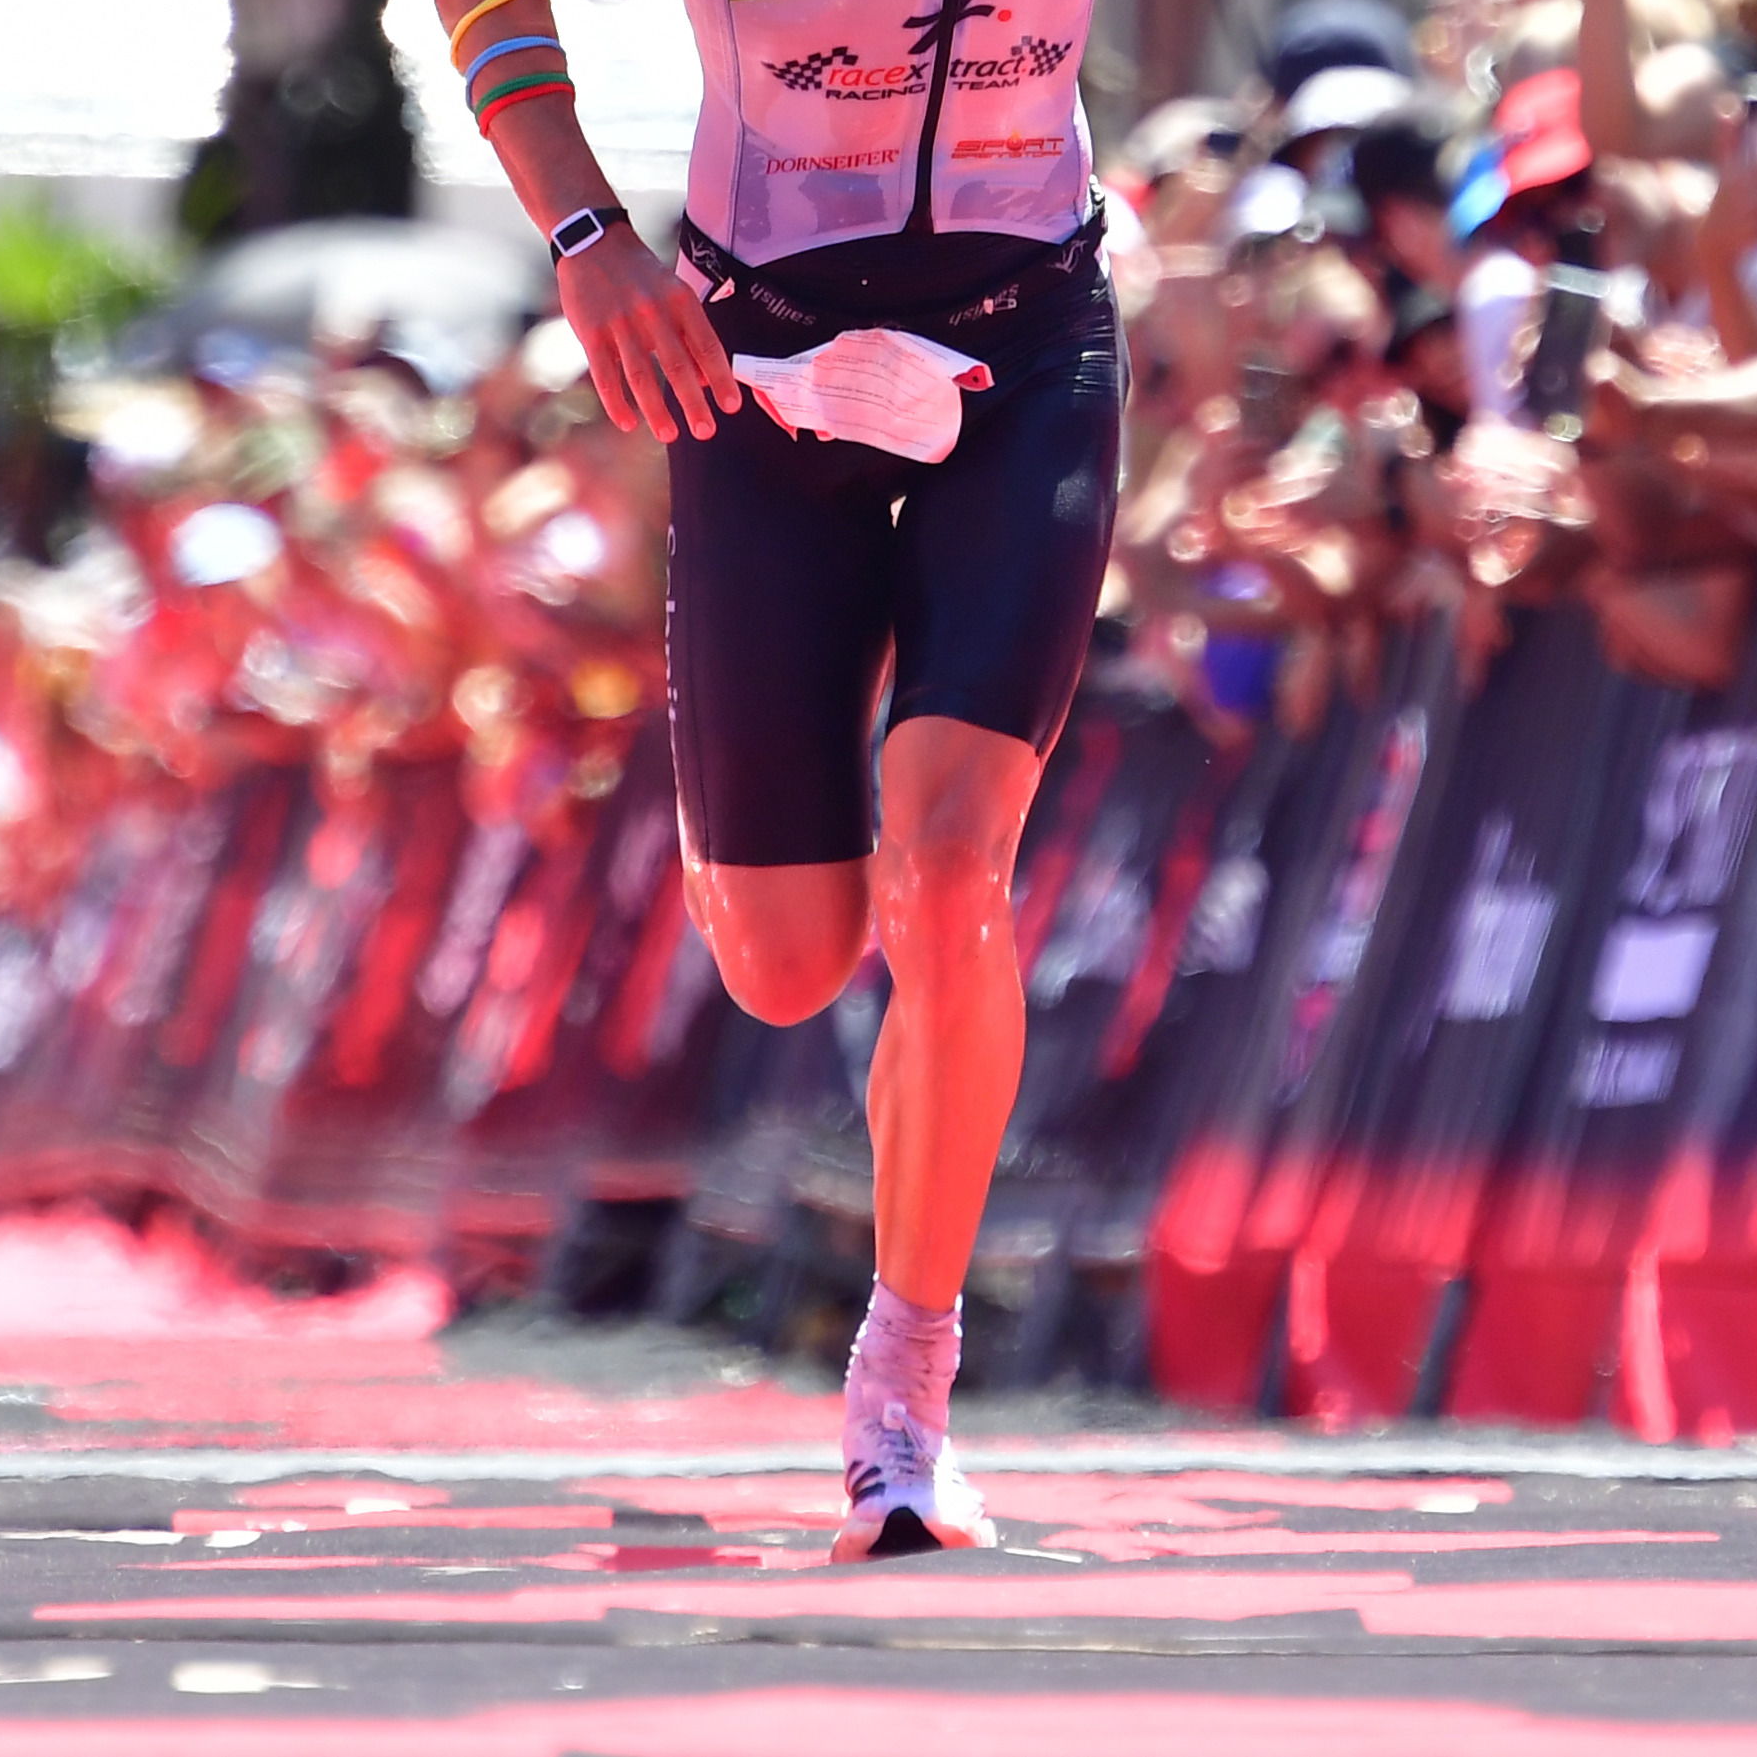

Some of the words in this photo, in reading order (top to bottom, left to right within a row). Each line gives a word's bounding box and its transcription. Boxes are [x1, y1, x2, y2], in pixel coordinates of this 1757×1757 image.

[824, 82, 927, 101] RACING
[951, 76, 1021, 91] TEAM
[954, 135, 1065, 152] SPORT
[749, 282, 817, 326] sailfish
